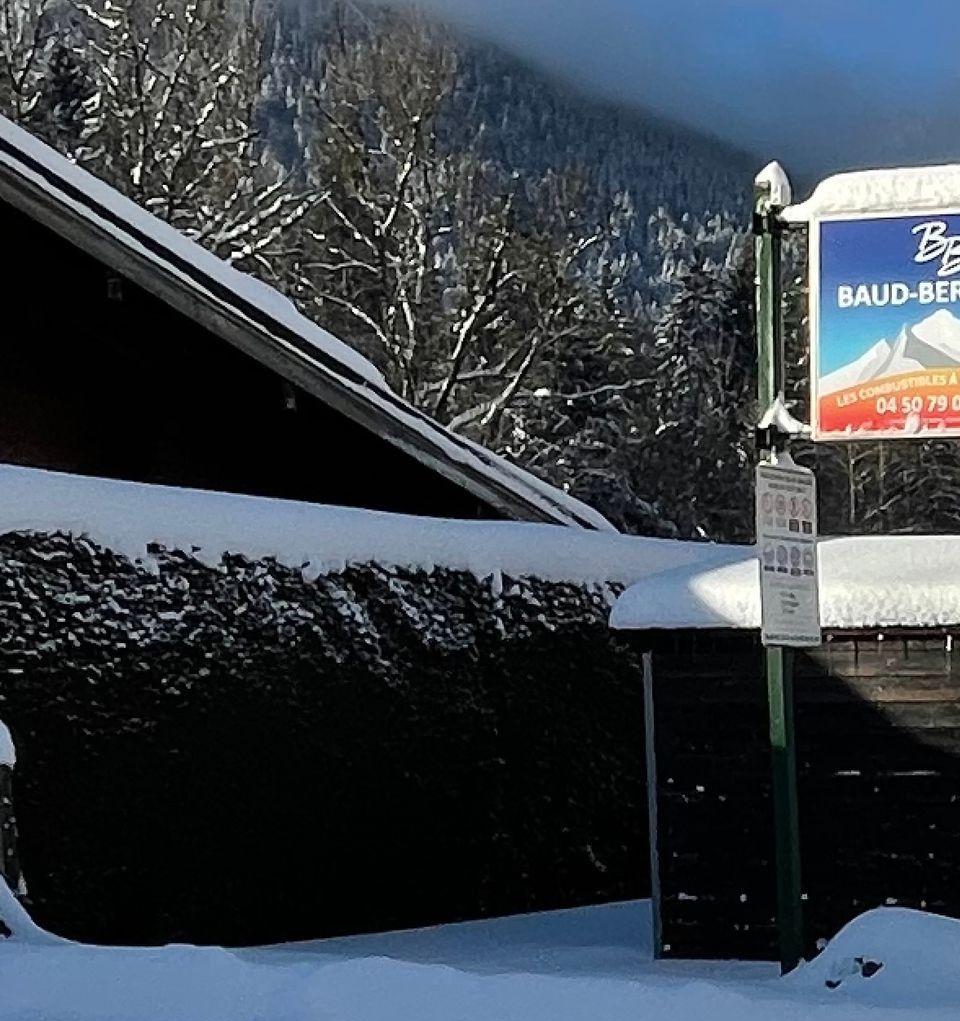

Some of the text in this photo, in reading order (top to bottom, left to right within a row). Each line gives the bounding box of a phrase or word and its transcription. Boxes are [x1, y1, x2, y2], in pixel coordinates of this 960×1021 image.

[837, 393, 858, 407] LES
[859, 375, 946, 400] COMBUSTIBLES
[950, 372, 958, 385] À
[876, 397, 897, 414] 04
[901, 396, 922, 413] 50
[927, 395, 948, 412] 79
